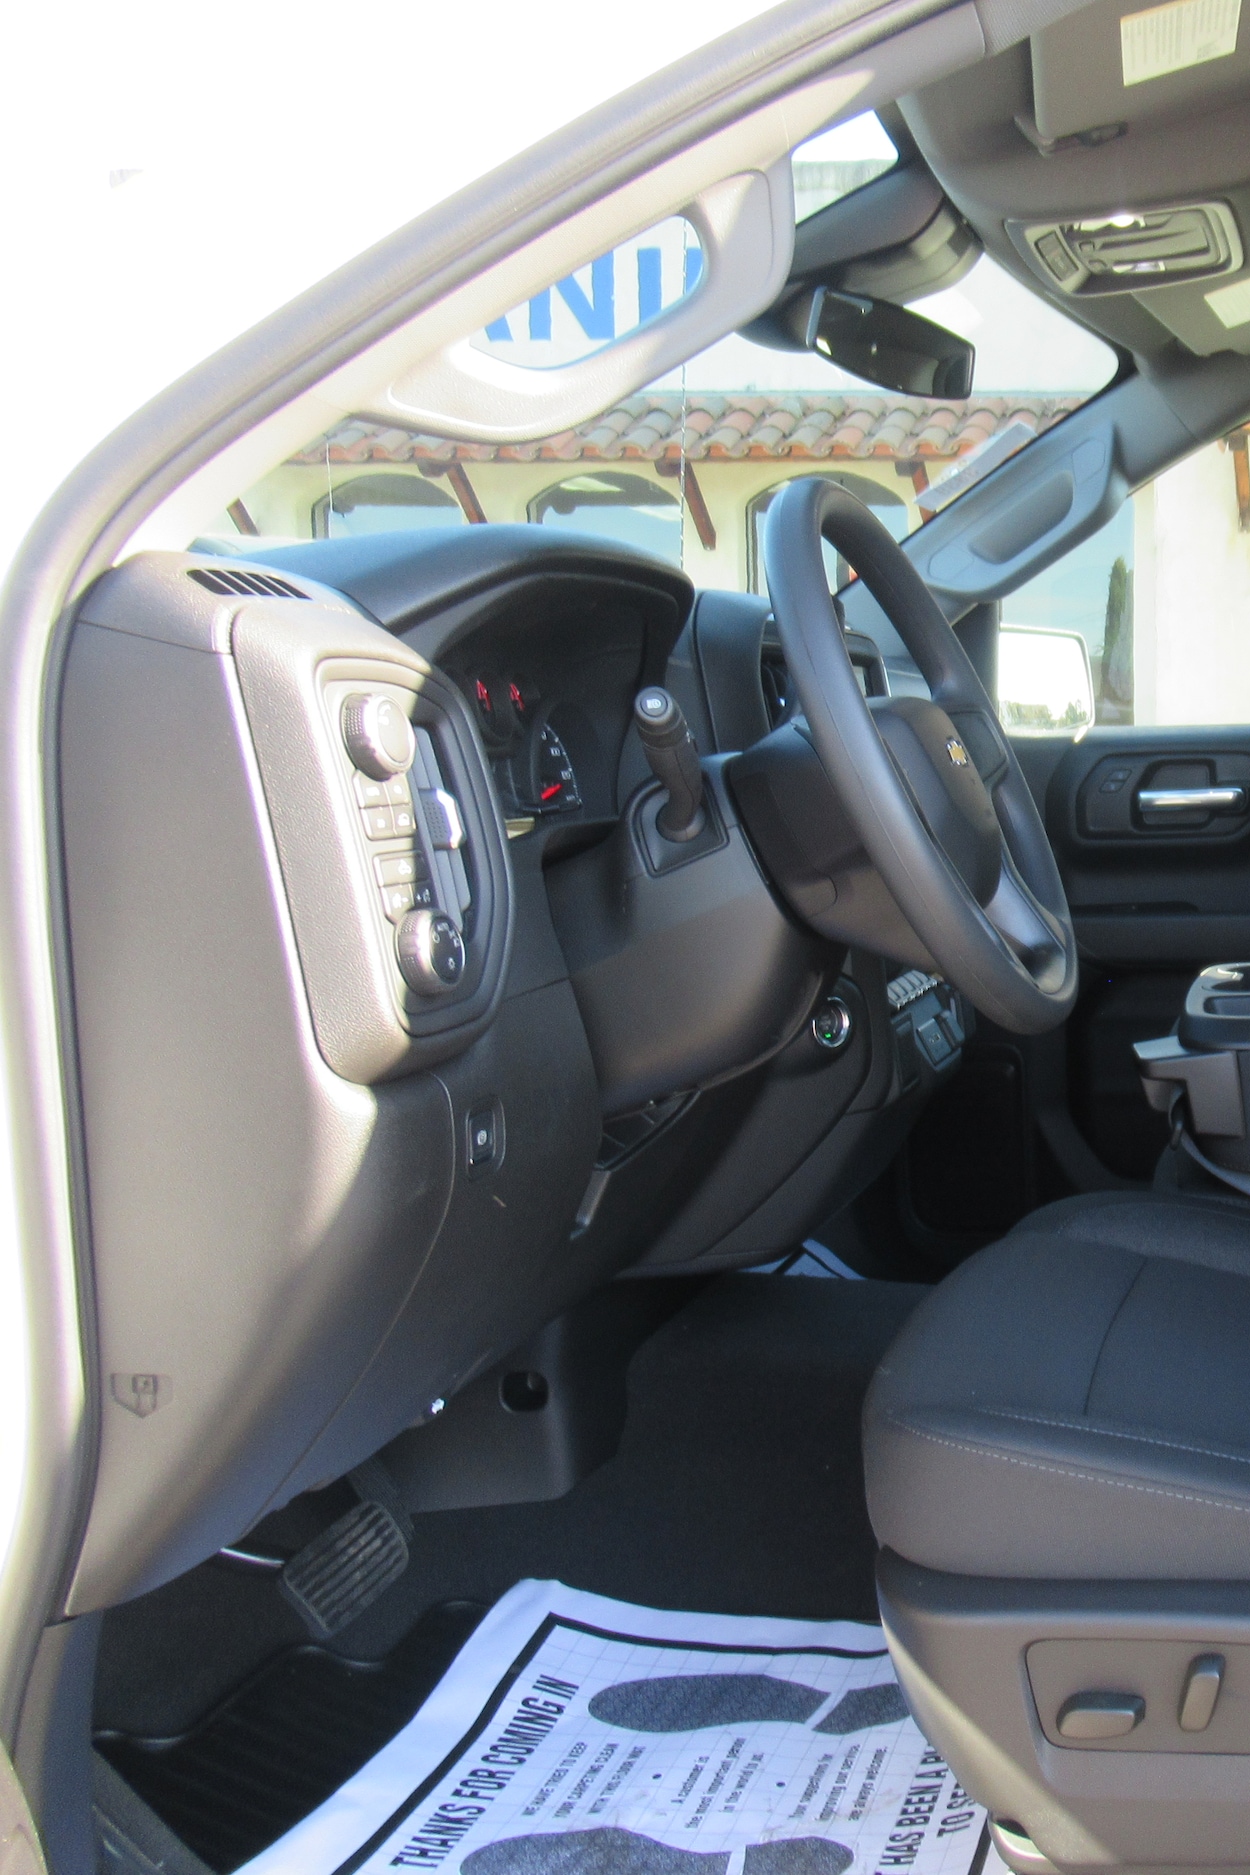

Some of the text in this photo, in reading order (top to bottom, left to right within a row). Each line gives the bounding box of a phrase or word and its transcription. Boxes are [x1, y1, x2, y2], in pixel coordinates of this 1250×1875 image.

[389, 1674, 579, 1868] THANKS FOR COMING IN
[914, 1768, 949, 1778] A
[895, 1783, 943, 1827] BEEN
[937, 1811, 975, 1838] TO
[879, 1832, 925, 1865] HAS
